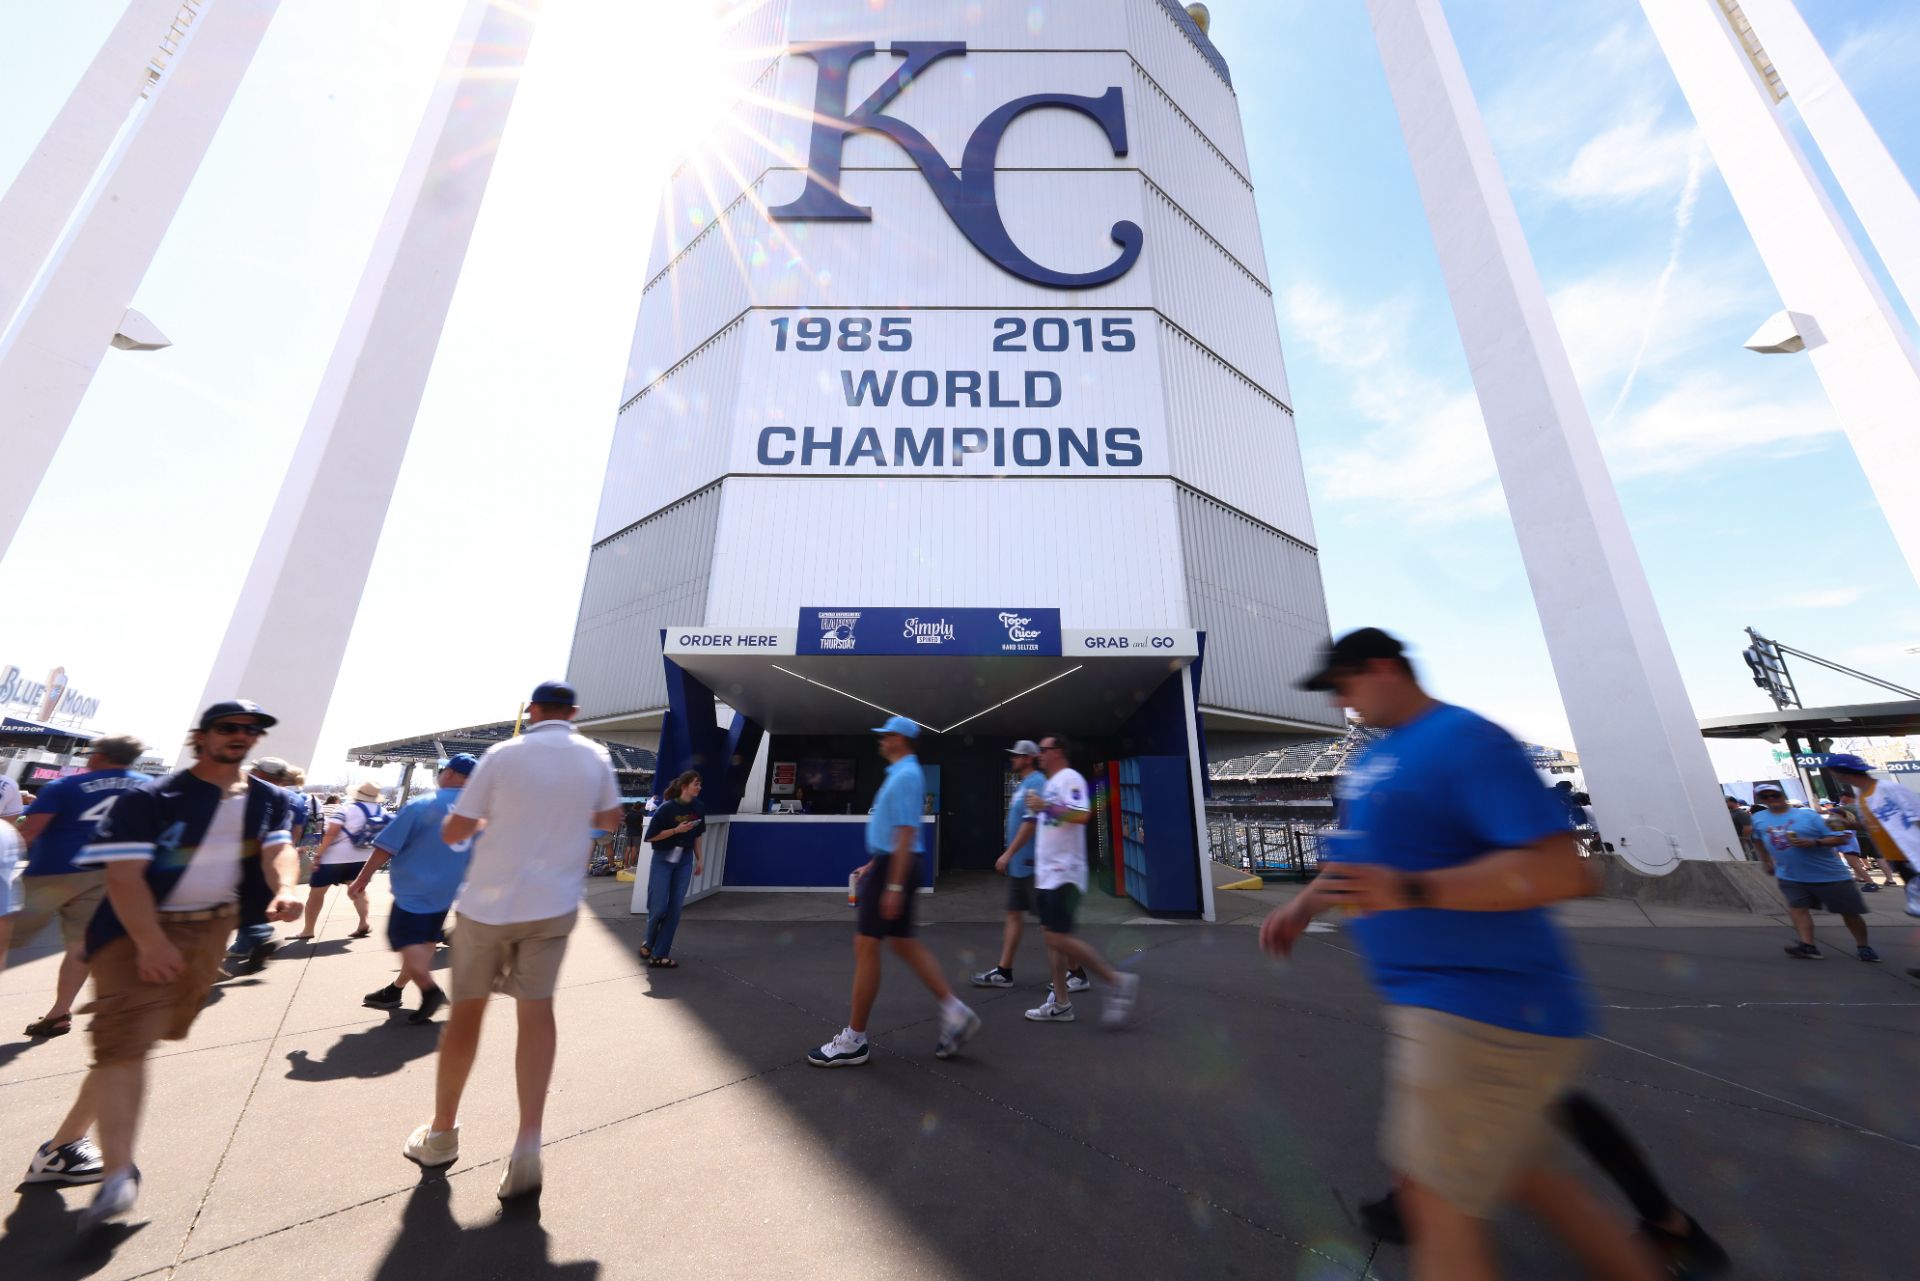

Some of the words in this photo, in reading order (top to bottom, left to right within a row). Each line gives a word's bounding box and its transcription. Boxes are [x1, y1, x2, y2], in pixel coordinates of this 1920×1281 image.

[768, 41, 1144, 291] KC
[770, 317, 913, 353] 1985
[992, 317, 1136, 353] 2015
[840, 370, 1063, 408] WORLD
[757, 427, 1144, 468] CHAMPIONS
[998, 612, 1032, 628] Topo
[903, 617, 956, 641] Simply
[1008, 626, 1041, 642] Chico
[679, 634, 733, 647] ORDER
[737, 635, 778, 647] HERE
[820, 638, 856, 650] THURSDAY
[1084, 636, 1129, 649] GRAB
[1132, 636, 1149, 648] and
[1151, 636, 1175, 649] GO
[0, 665, 46, 706] BLUE
[60, 688, 100, 719] MOON
[1, 725, 45, 733] TAPROOM
[1797, 756, 1822, 766] 201
[1887, 763, 1910, 772] 201
